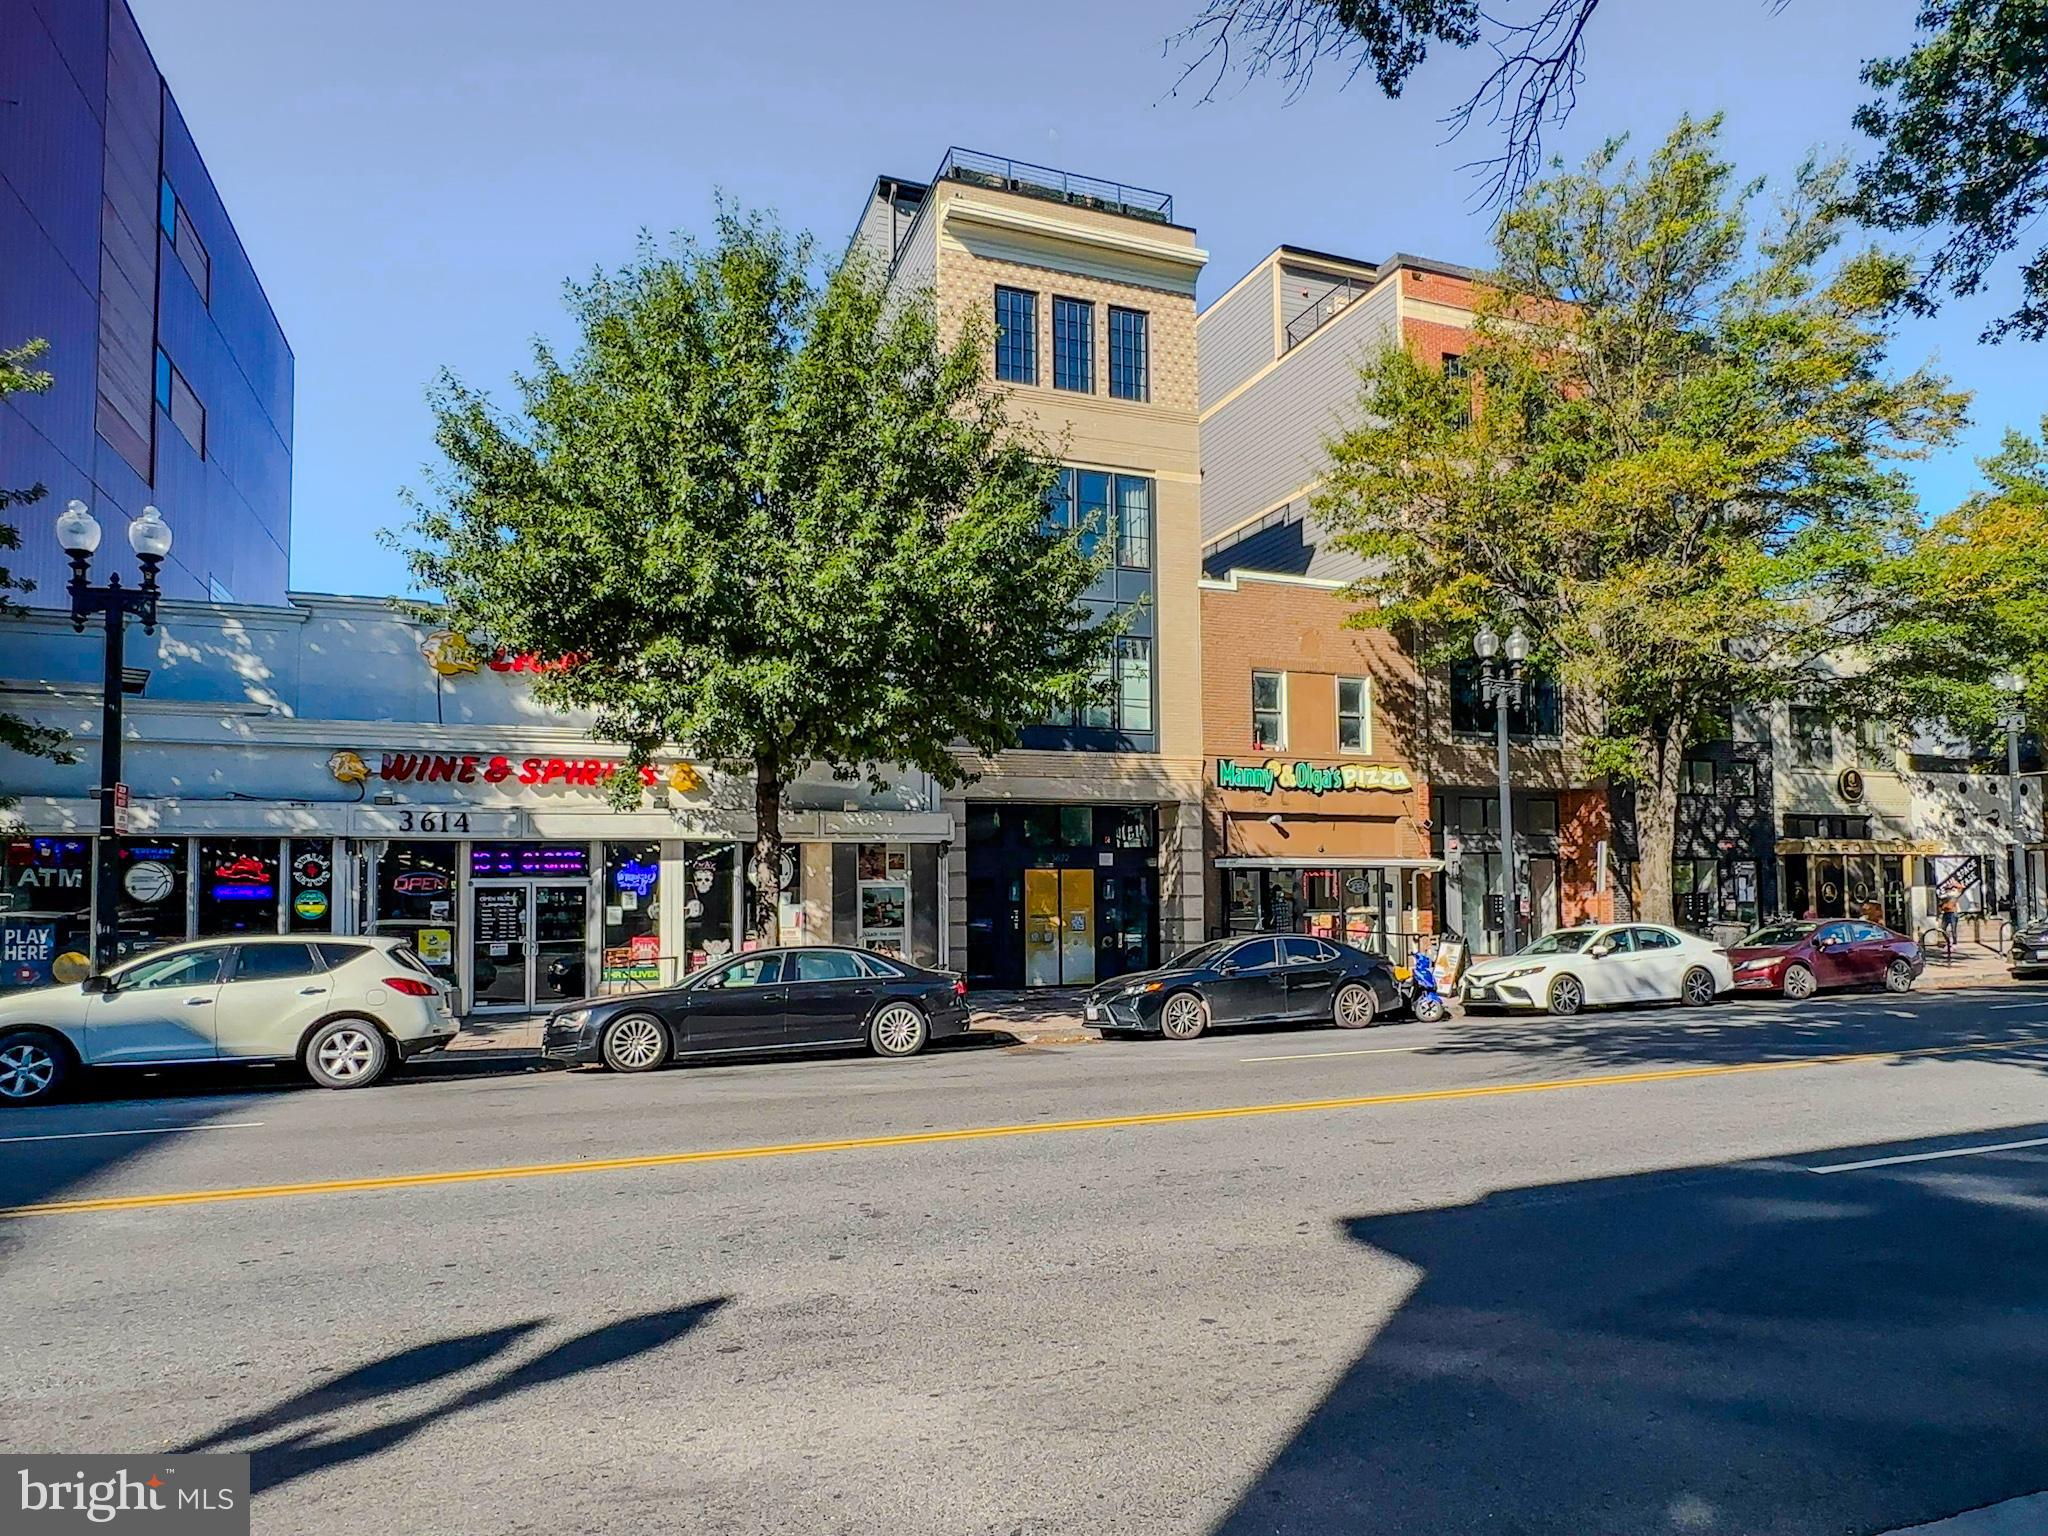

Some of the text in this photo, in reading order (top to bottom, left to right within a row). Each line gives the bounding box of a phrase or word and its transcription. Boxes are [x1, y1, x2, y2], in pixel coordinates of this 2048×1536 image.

[381, 753, 658, 787] WINE & SPIRIS
[1219, 759, 1275, 793] Manny
[1280, 764, 1297, 789] &
[1295, 762, 1342, 793] Olga's
[399, 810, 470, 833] 3614
[1889, 843, 1936, 853] LOUNGE
[17, 867, 82, 888] ATM
[393, 876, 449, 891] OPEN
[4, 928, 50, 945] PLAY
[4, 944, 49, 961] HERE
